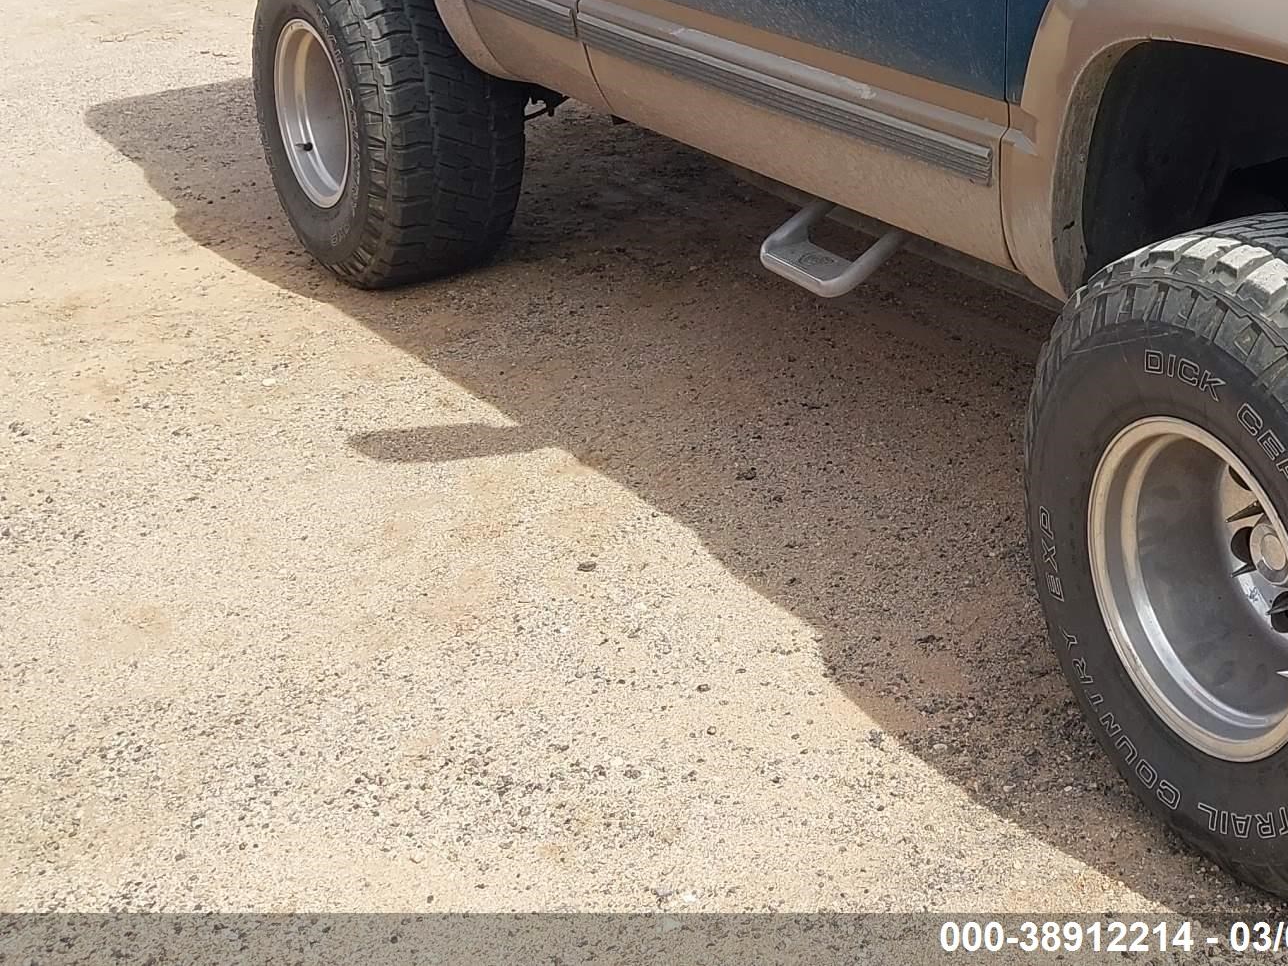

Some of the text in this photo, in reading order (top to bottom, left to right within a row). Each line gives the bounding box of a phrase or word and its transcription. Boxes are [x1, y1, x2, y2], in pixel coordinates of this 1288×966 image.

[1144, 349, 1226, 402] DICK
[1039, 505, 1065, 603] EXP
[1060, 626, 1182, 810] COUNTRY
